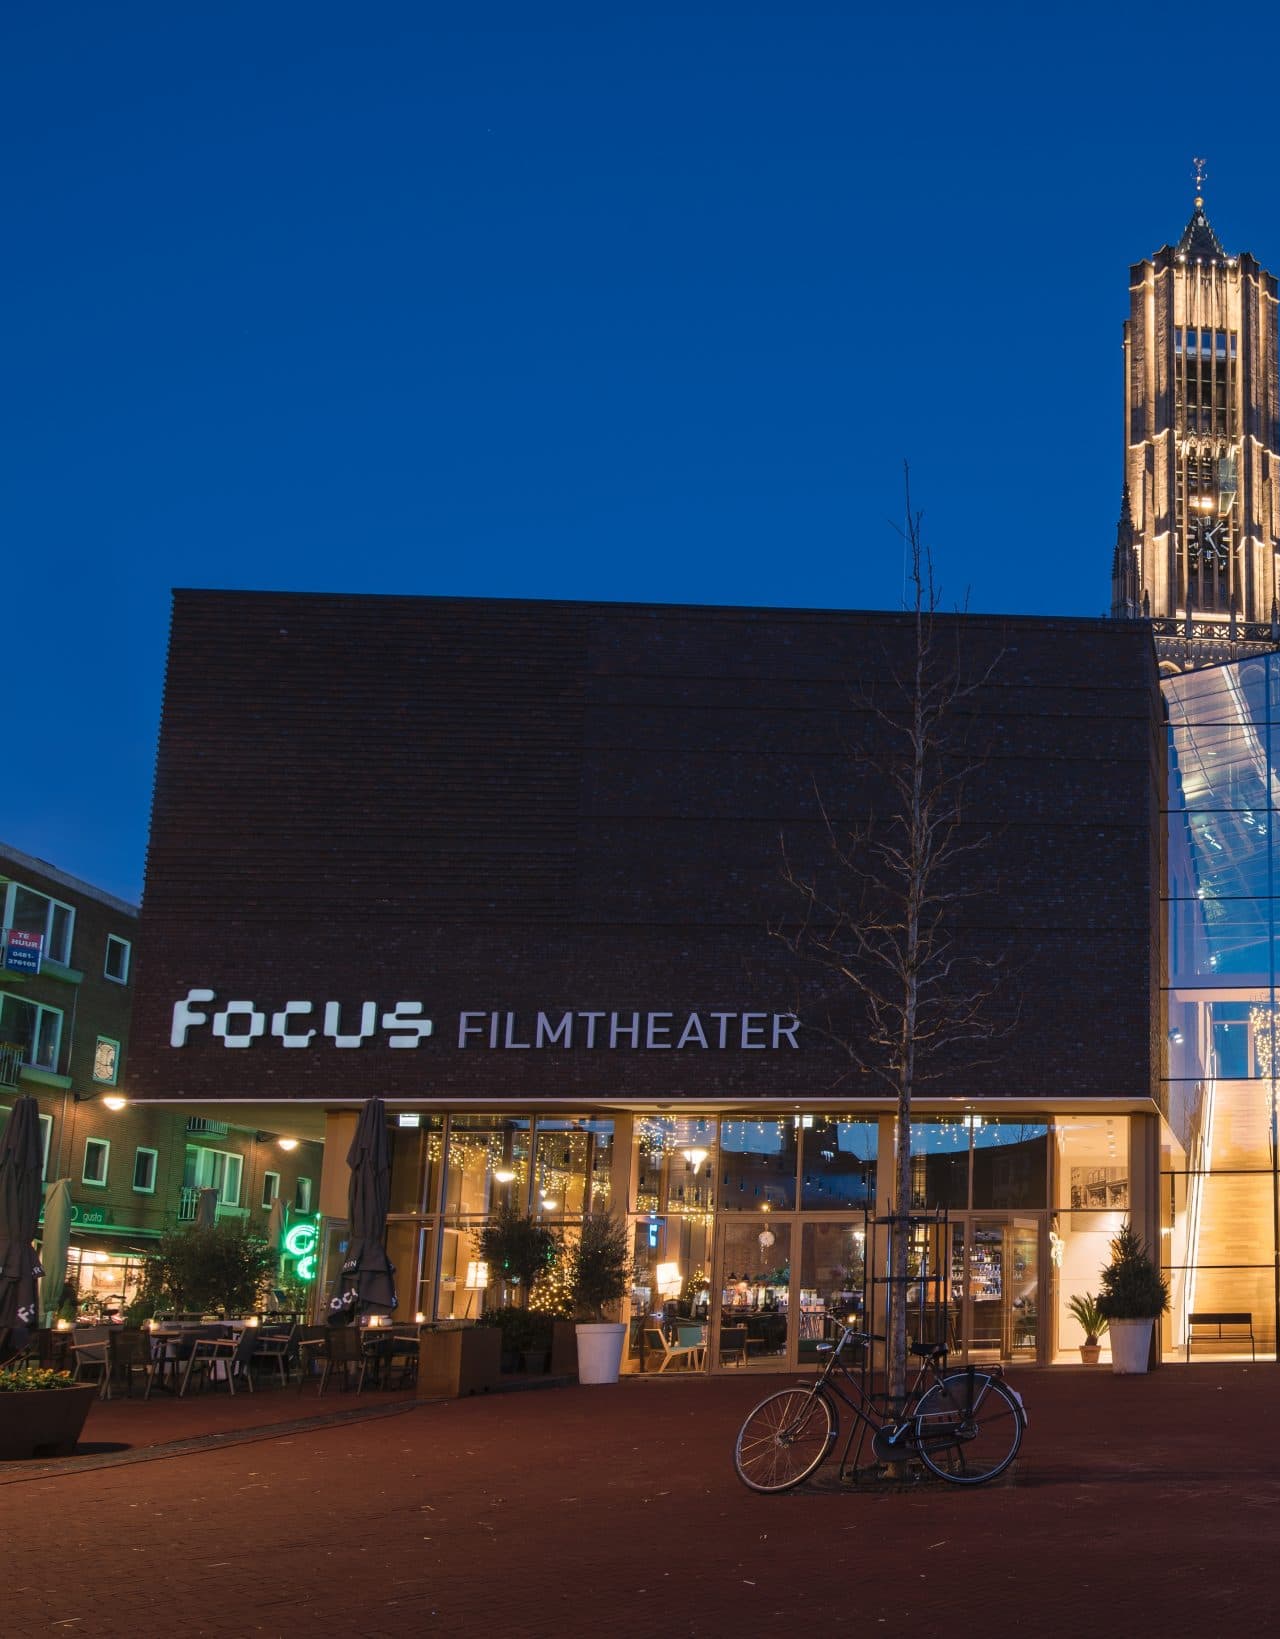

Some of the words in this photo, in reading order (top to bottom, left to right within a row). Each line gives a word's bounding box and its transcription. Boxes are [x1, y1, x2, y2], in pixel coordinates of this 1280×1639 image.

[11, 938, 38, 948] HUUR
[170, 988, 433, 1049] FOCUS
[457, 1011, 799, 1049] FILMTHEATER
